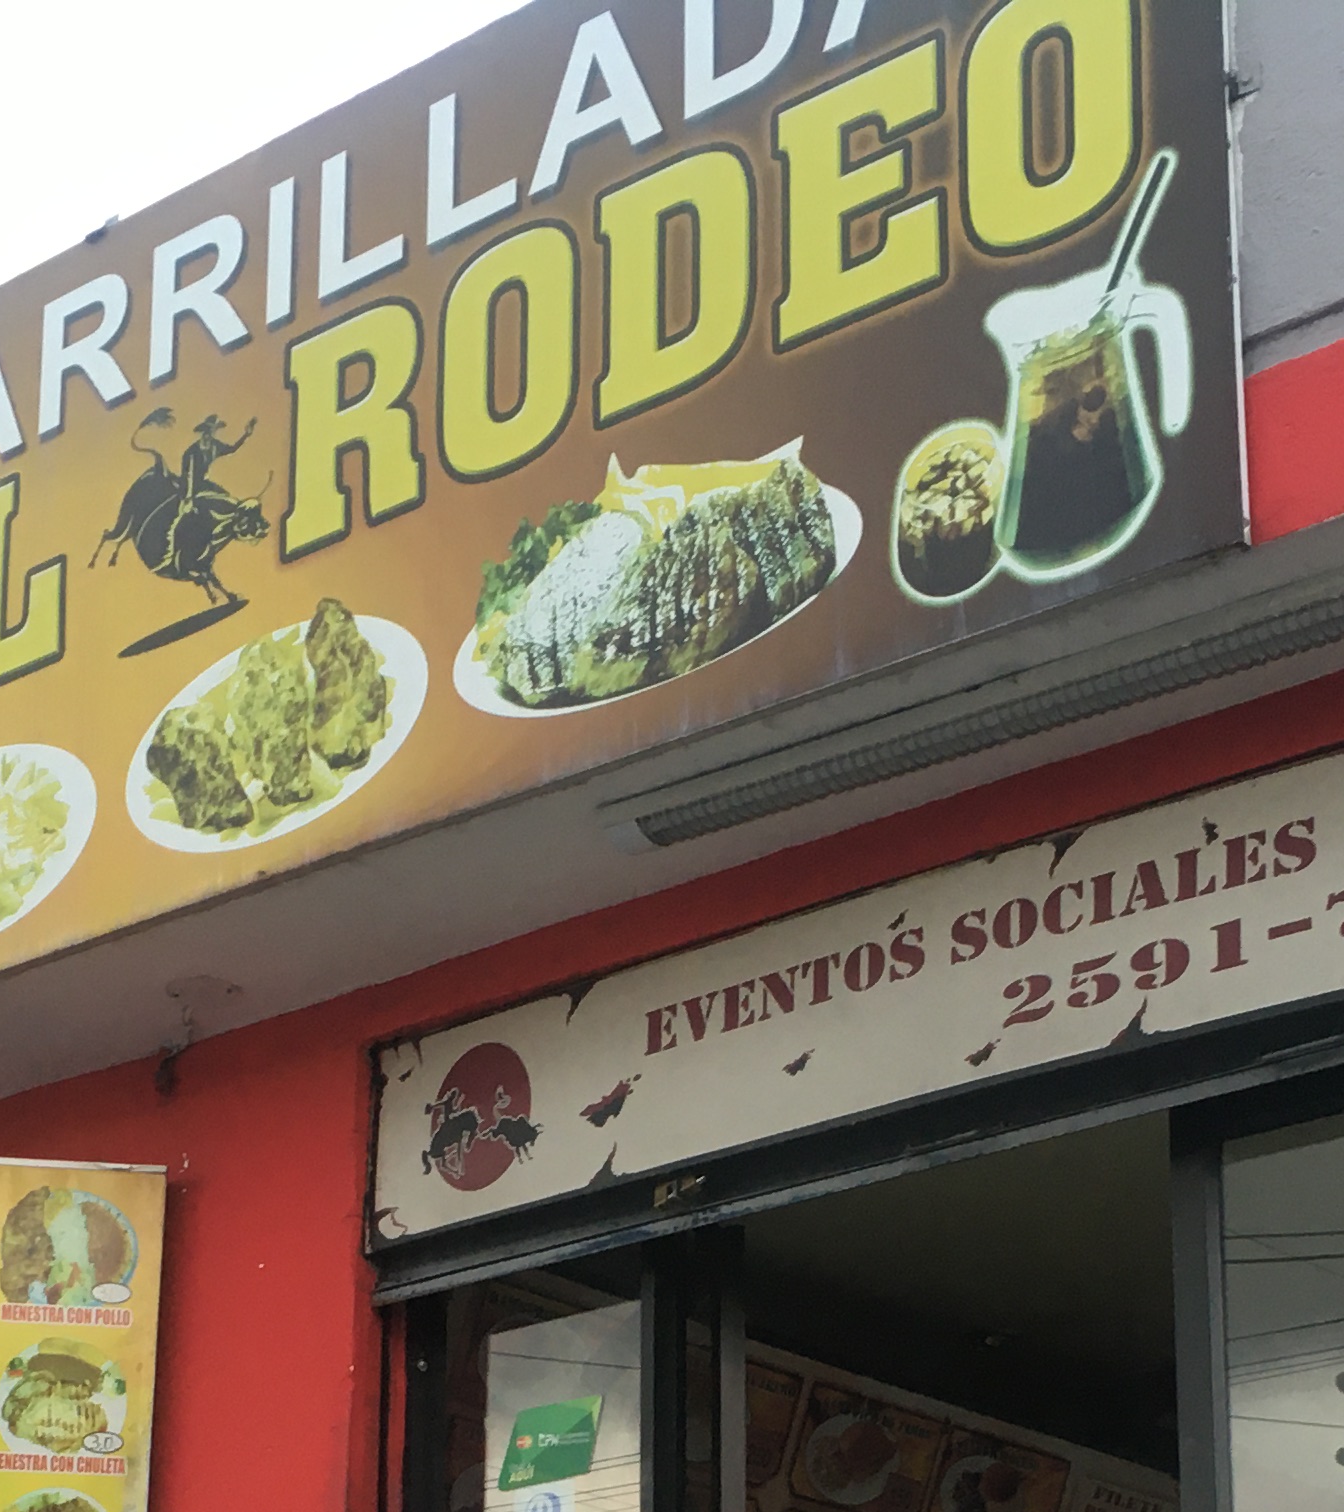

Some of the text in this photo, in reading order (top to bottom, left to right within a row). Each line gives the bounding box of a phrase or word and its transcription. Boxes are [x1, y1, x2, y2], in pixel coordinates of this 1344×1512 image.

[279, 0, 1143, 562] RODEO
[644, 925, 926, 1057] EVENTOS
[950, 816, 1318, 965] SOCIALES
[1, 1303, 131, 1326] MENESTRA CON POLLO
[49, 1455, 74, 1473] CON
[76, 1456, 126, 1474] CHULETA
